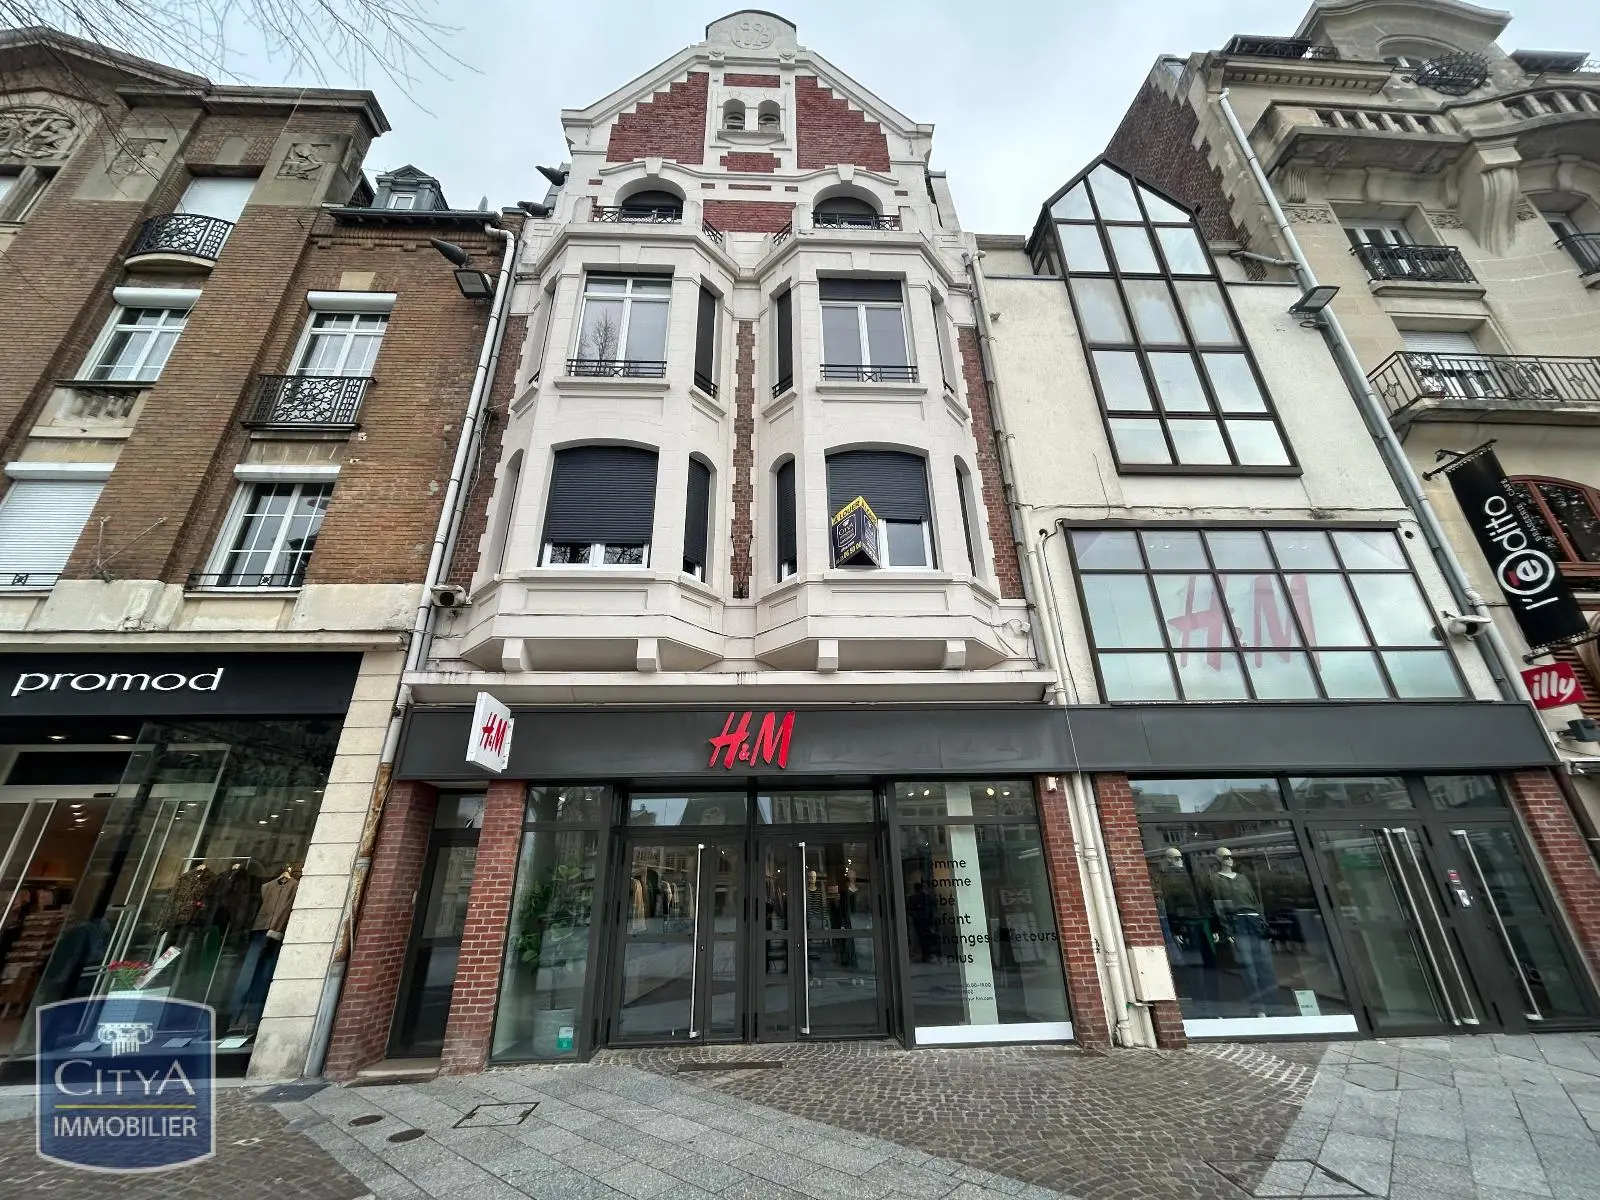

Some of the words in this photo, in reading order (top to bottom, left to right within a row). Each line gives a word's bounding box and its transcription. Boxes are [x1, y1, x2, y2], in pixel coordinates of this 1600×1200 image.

[11, 667, 225, 697] promod
[1533, 671, 1576, 702] illy
[480, 711, 508, 757] H&M
[709, 710, 796, 769] H&M
[931, 913, 972, 925] nfant
[1009, 929, 1058, 942] etours
